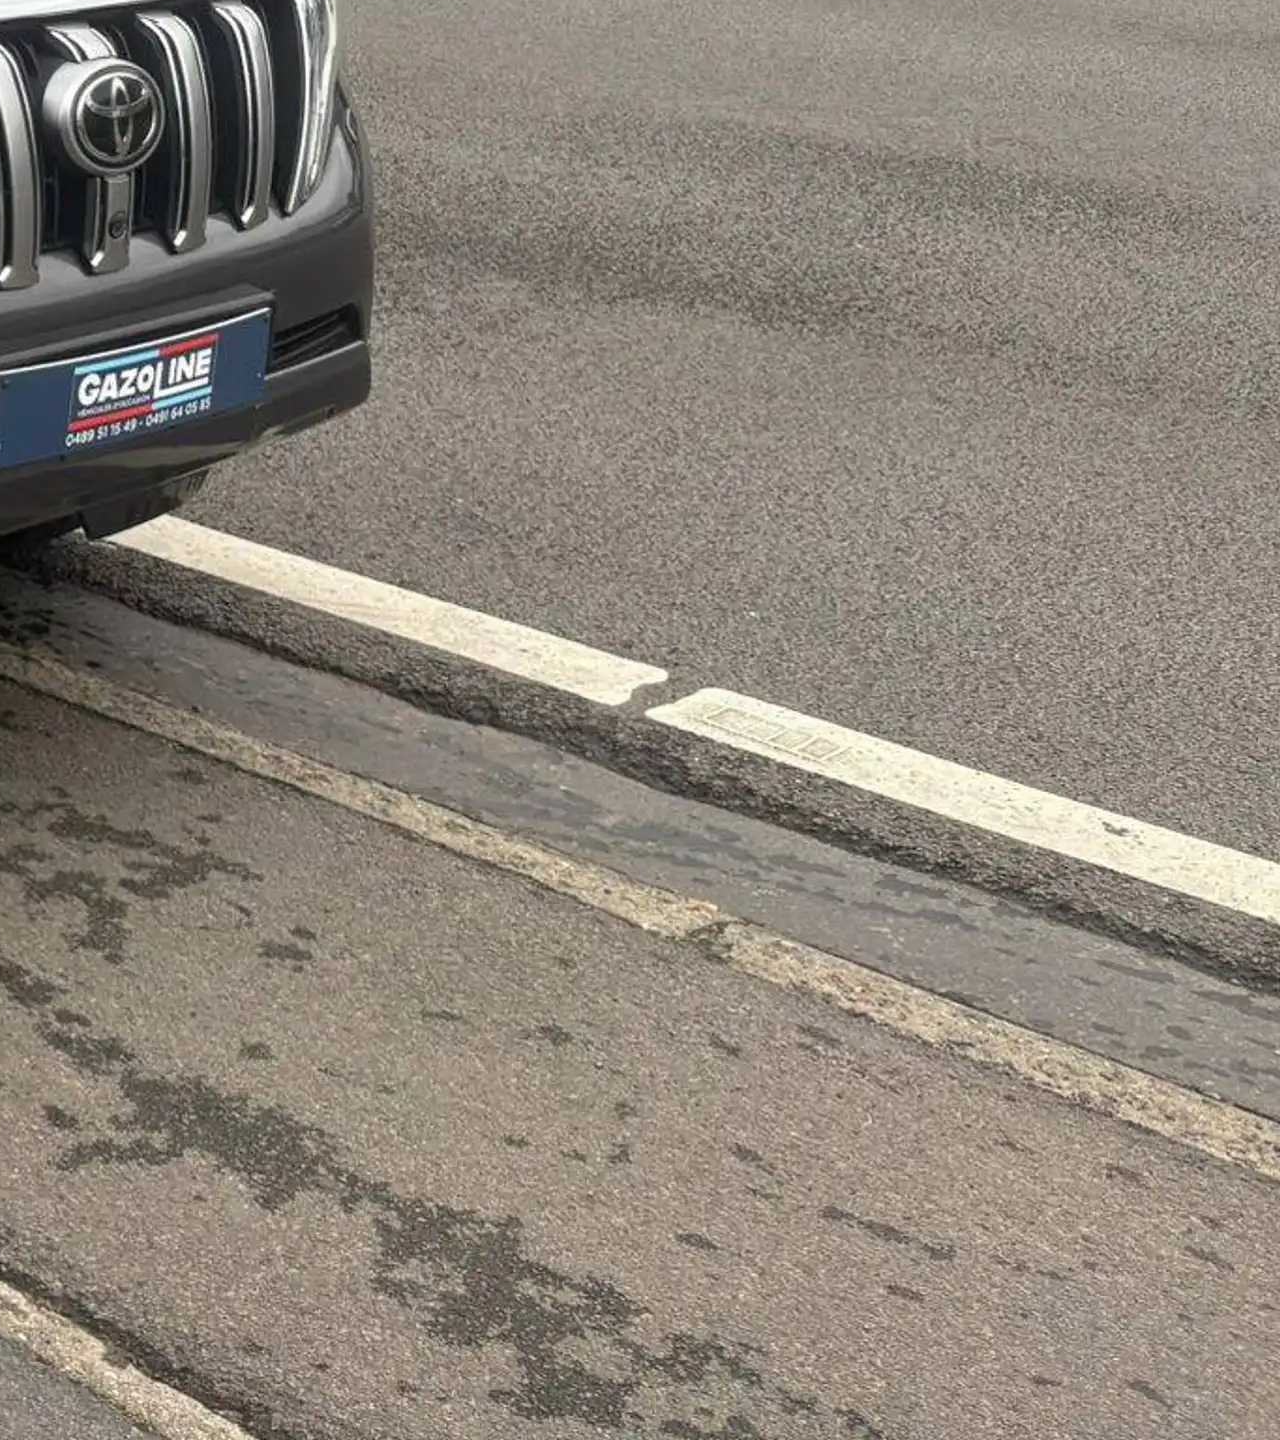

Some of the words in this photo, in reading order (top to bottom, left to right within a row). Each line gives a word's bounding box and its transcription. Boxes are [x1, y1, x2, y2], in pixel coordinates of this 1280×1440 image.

[78, 347, 214, 406] GAZOLINE
[65, 428, 95, 447] 0489
[96, 424, 109, 441] 51
[123, 417, 138, 433] 49
[184, 400, 198, 416] 05
